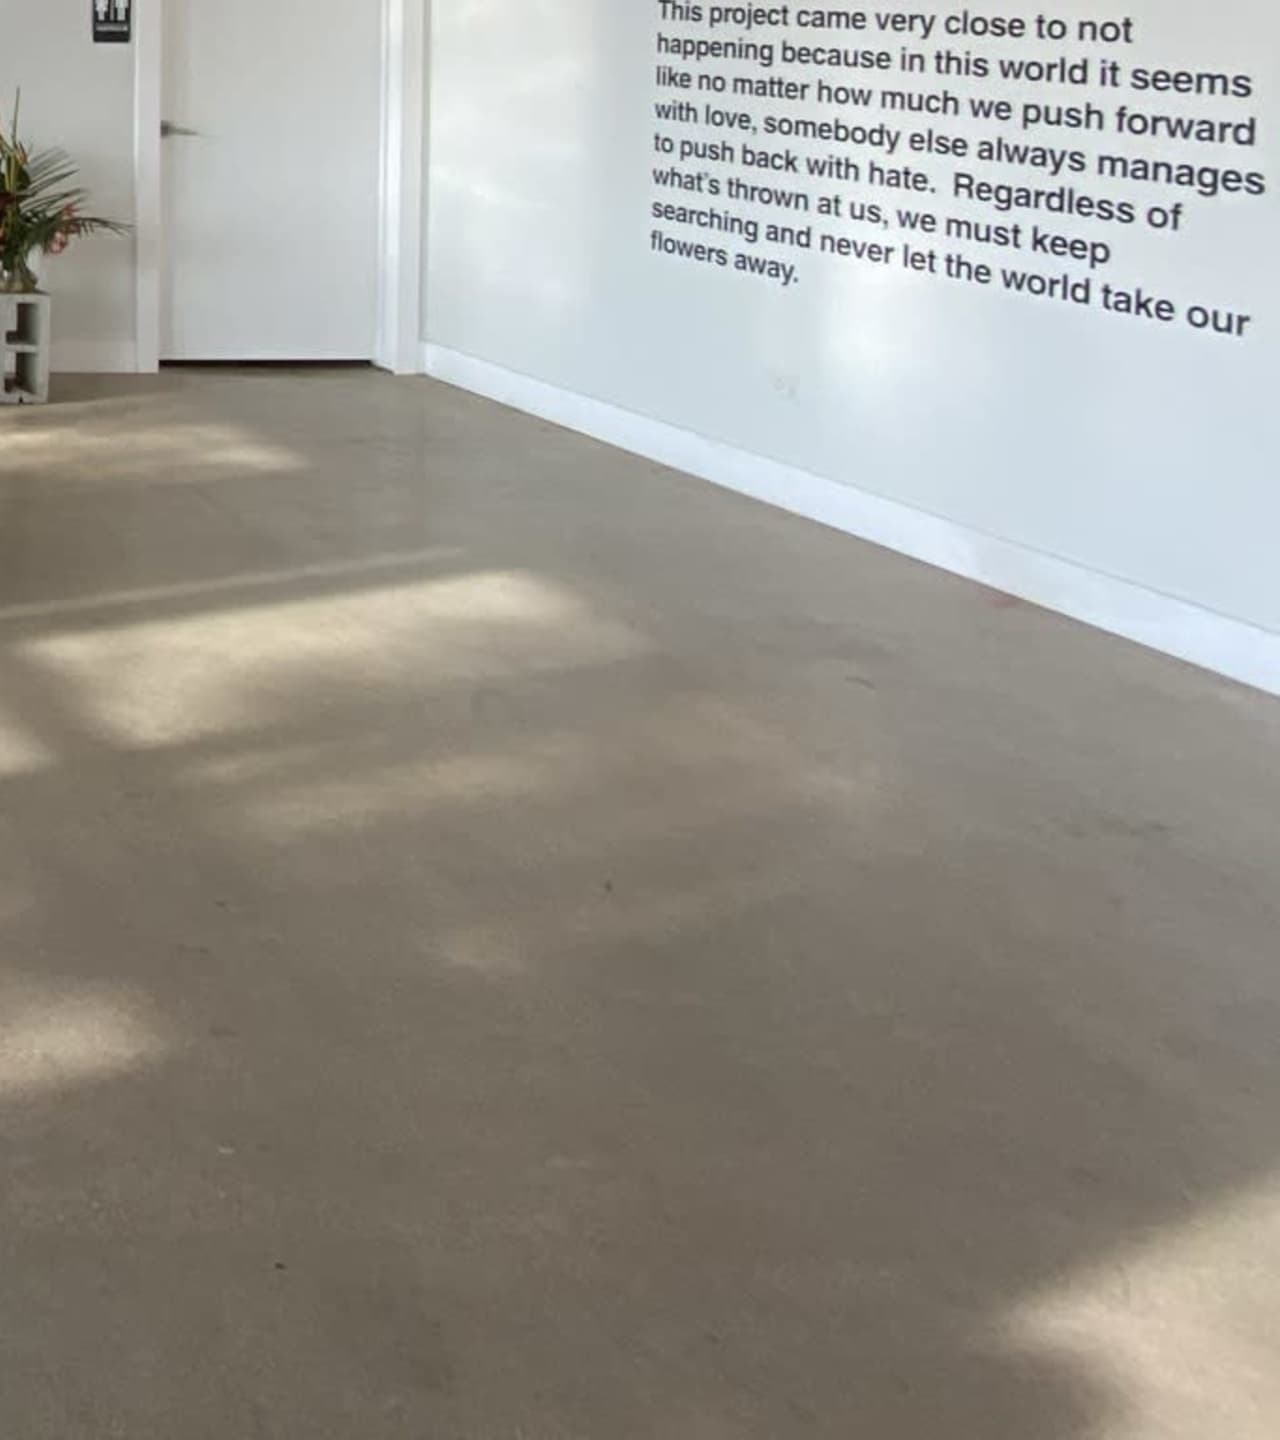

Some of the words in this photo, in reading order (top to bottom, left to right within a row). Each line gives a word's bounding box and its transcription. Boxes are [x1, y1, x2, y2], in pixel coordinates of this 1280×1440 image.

[656, 31, 775, 69] happening
[780, 38, 894, 71] because
[899, 45, 927, 74] in
[933, 48, 991, 79] this
[997, 55, 1090, 87] world
[1099, 58, 1122, 89] it
[1129, 67, 1254, 99] seems
[708, 1, 791, 32] project
[795, 8, 868, 31] came
[873, 11, 938, 41] very
[943, 8, 1027, 39] close
[1033, 13, 1070, 41] to
[1076, 16, 1134, 45] not
[653, 98, 700, 125] with
[703, 103, 759, 137] love,
[762, 114, 903, 156] somebody
[907, 127, 970, 159] else
[975, 135, 1088, 178] always
[1096, 154, 1267, 199] manages
[655, 64, 693, 90] like
[697, 73, 728, 94] no
[731, 75, 812, 102] matter
[816, 77, 874, 108] how
[879, 89, 961, 117] much
[967, 97, 1014, 122] we
[1021, 100, 1106, 132] push
[1114, 104, 1257, 147] forward
[651, 165, 722, 197] what's
[725, 176, 811, 213] thrown
[815, 193, 843, 219] at
[848, 200, 890, 231] us,
[895, 208, 939, 234] we
[944, 216, 1023, 250] must
[1030, 224, 1112, 271] keep
[653, 131, 676, 155] to
[679, 138, 736, 165] push
[740, 141, 801, 175] back
[804, 153, 861, 183] with
[867, 158, 937, 195] hate.
[952, 171, 1137, 225] Regardless
[1145, 201, 1185, 232] of
[649, 229, 729, 268] flowers
[733, 252, 800, 287] away.
[651, 201, 760, 245] searching
[764, 223, 814, 250] and
[819, 233, 897, 265] never
[902, 242, 939, 275] let
[943, 252, 993, 285] the
[999, 268, 1093, 306] world
[1099, 282, 1177, 323] take
[1185, 305, 1252, 337] our
